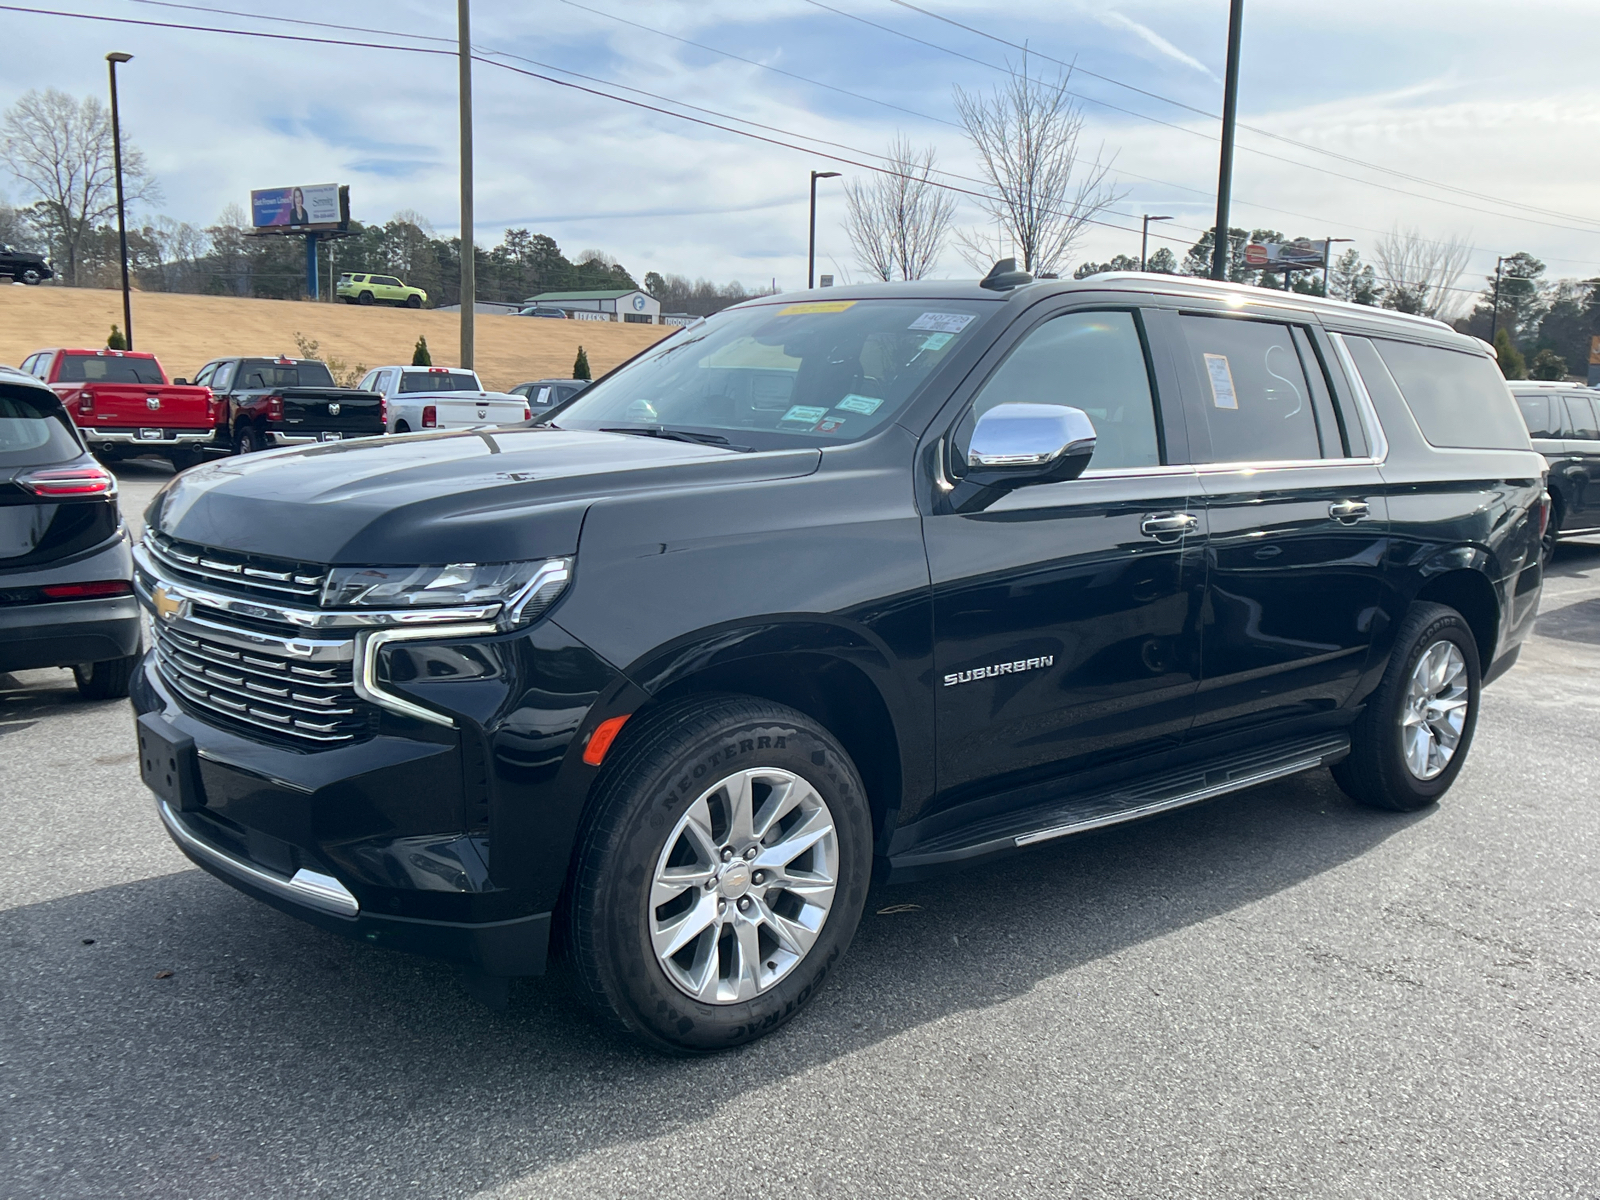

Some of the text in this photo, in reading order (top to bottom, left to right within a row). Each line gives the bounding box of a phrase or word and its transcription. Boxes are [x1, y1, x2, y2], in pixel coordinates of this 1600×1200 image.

[943, 655, 1054, 687] SUBURBAN
[661, 735, 788, 812] NEOTERRA
[725, 942, 840, 1040] NEOTRAC
